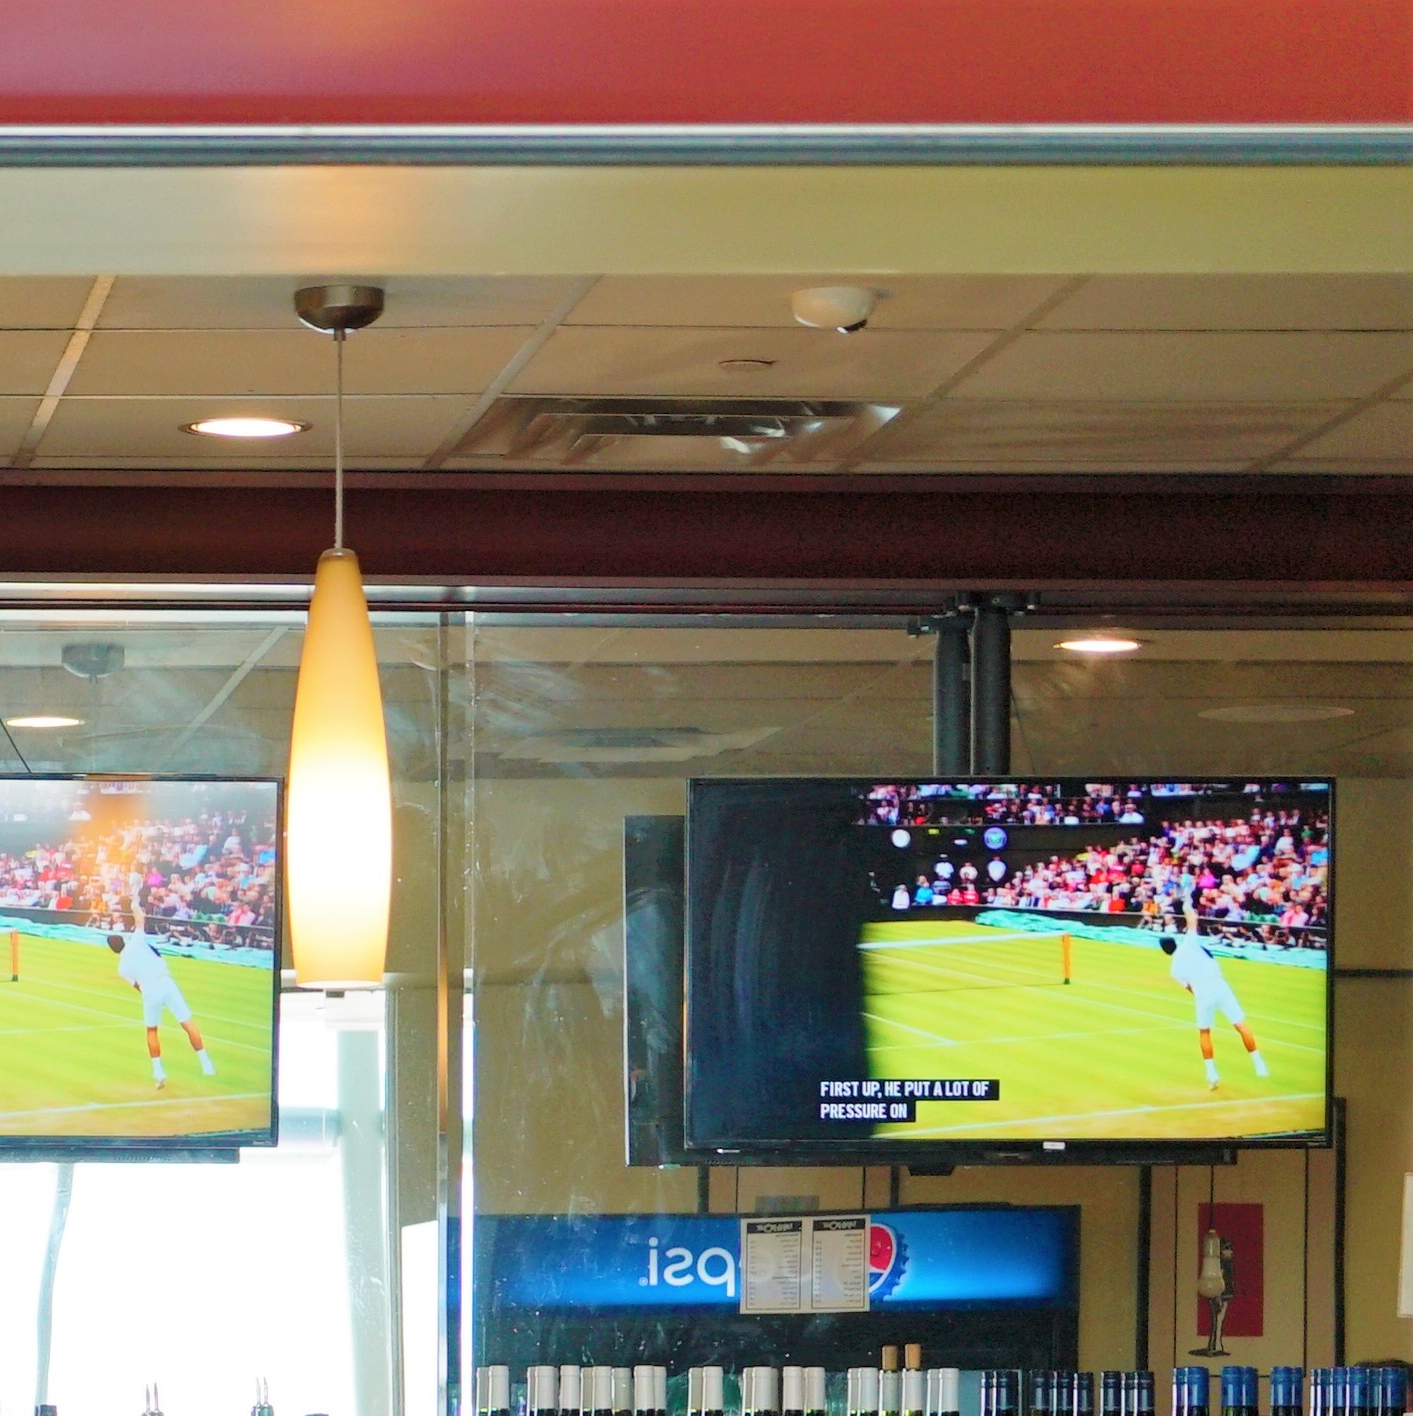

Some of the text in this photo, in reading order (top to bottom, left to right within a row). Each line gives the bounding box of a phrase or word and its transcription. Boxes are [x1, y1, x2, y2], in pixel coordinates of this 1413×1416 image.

[820, 1081, 989, 1099] FIRST UP, HE PUT A LOT OF
[820, 1103, 907, 1119] PRESSURE ON
